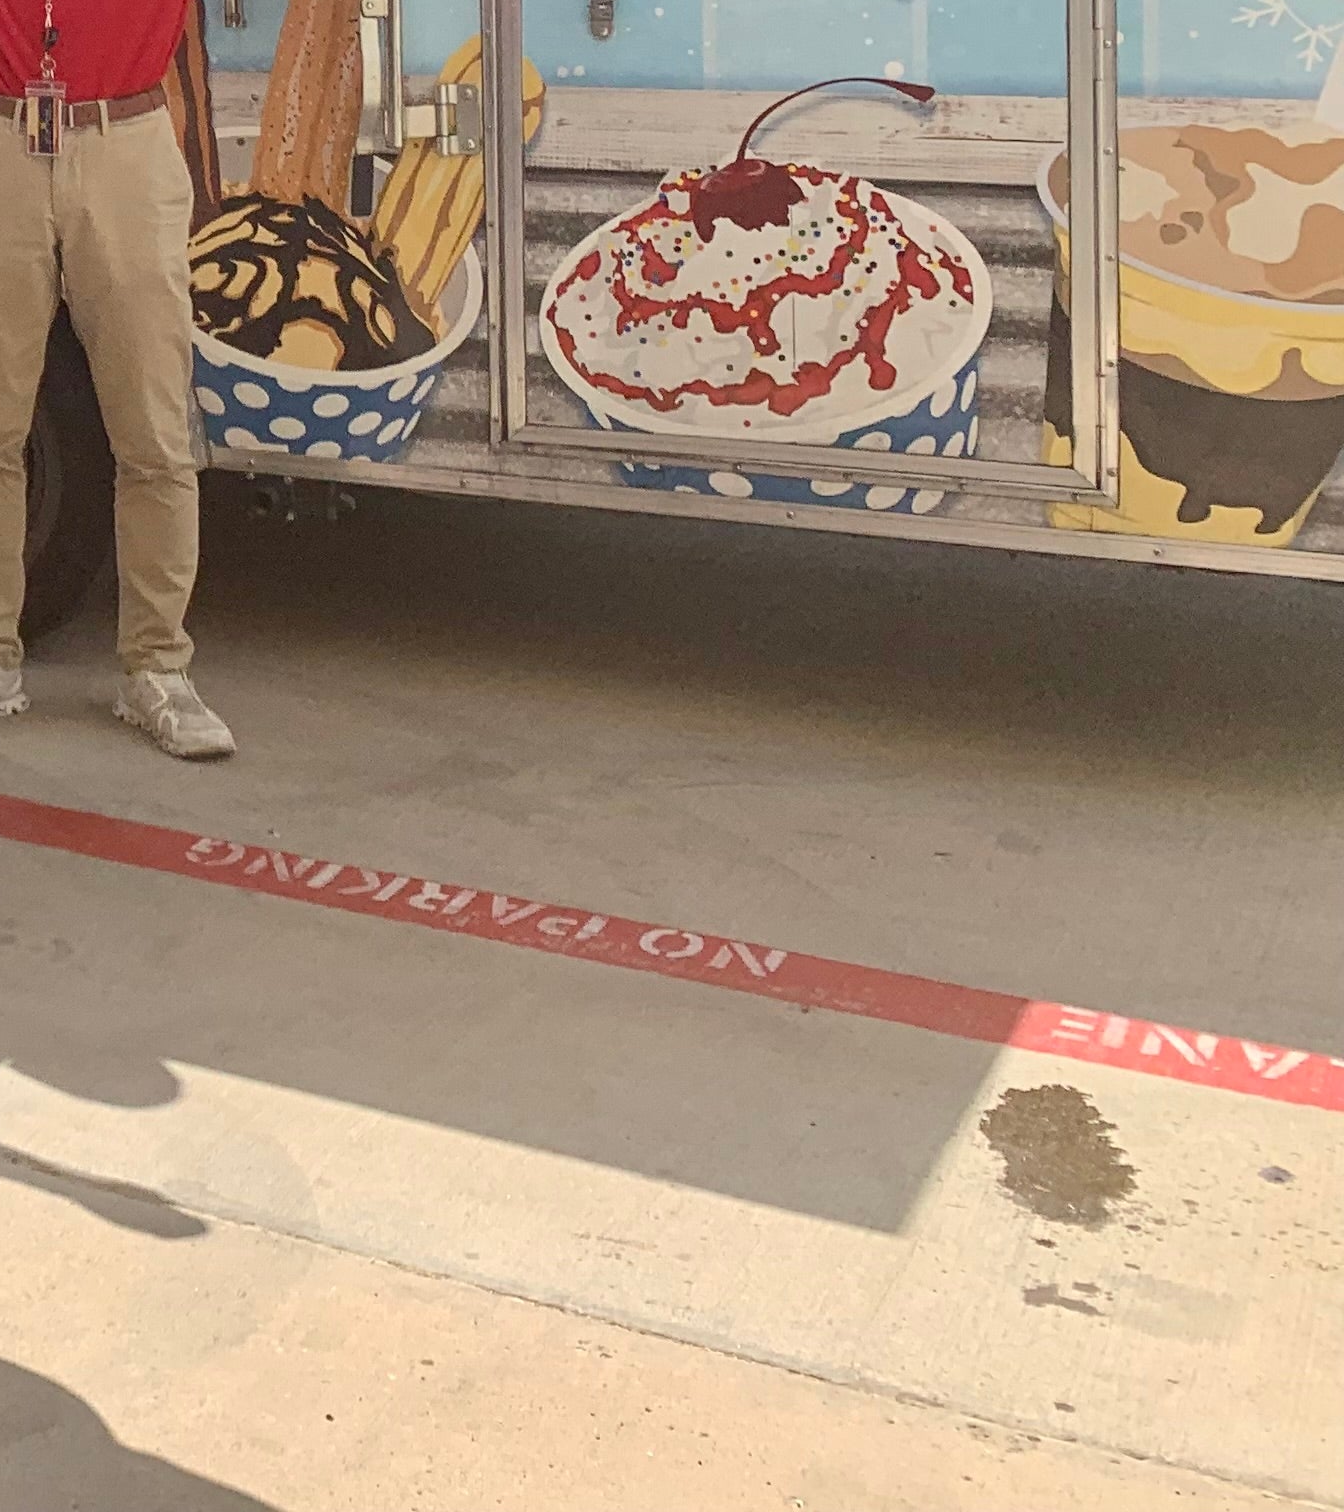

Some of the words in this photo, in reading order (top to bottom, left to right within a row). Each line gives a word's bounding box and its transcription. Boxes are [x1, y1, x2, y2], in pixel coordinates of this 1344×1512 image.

[184, 836, 609, 941] PARKING
[637, 926, 787, 978] NO
[1049, 1006, 1344, 1080] ANE
